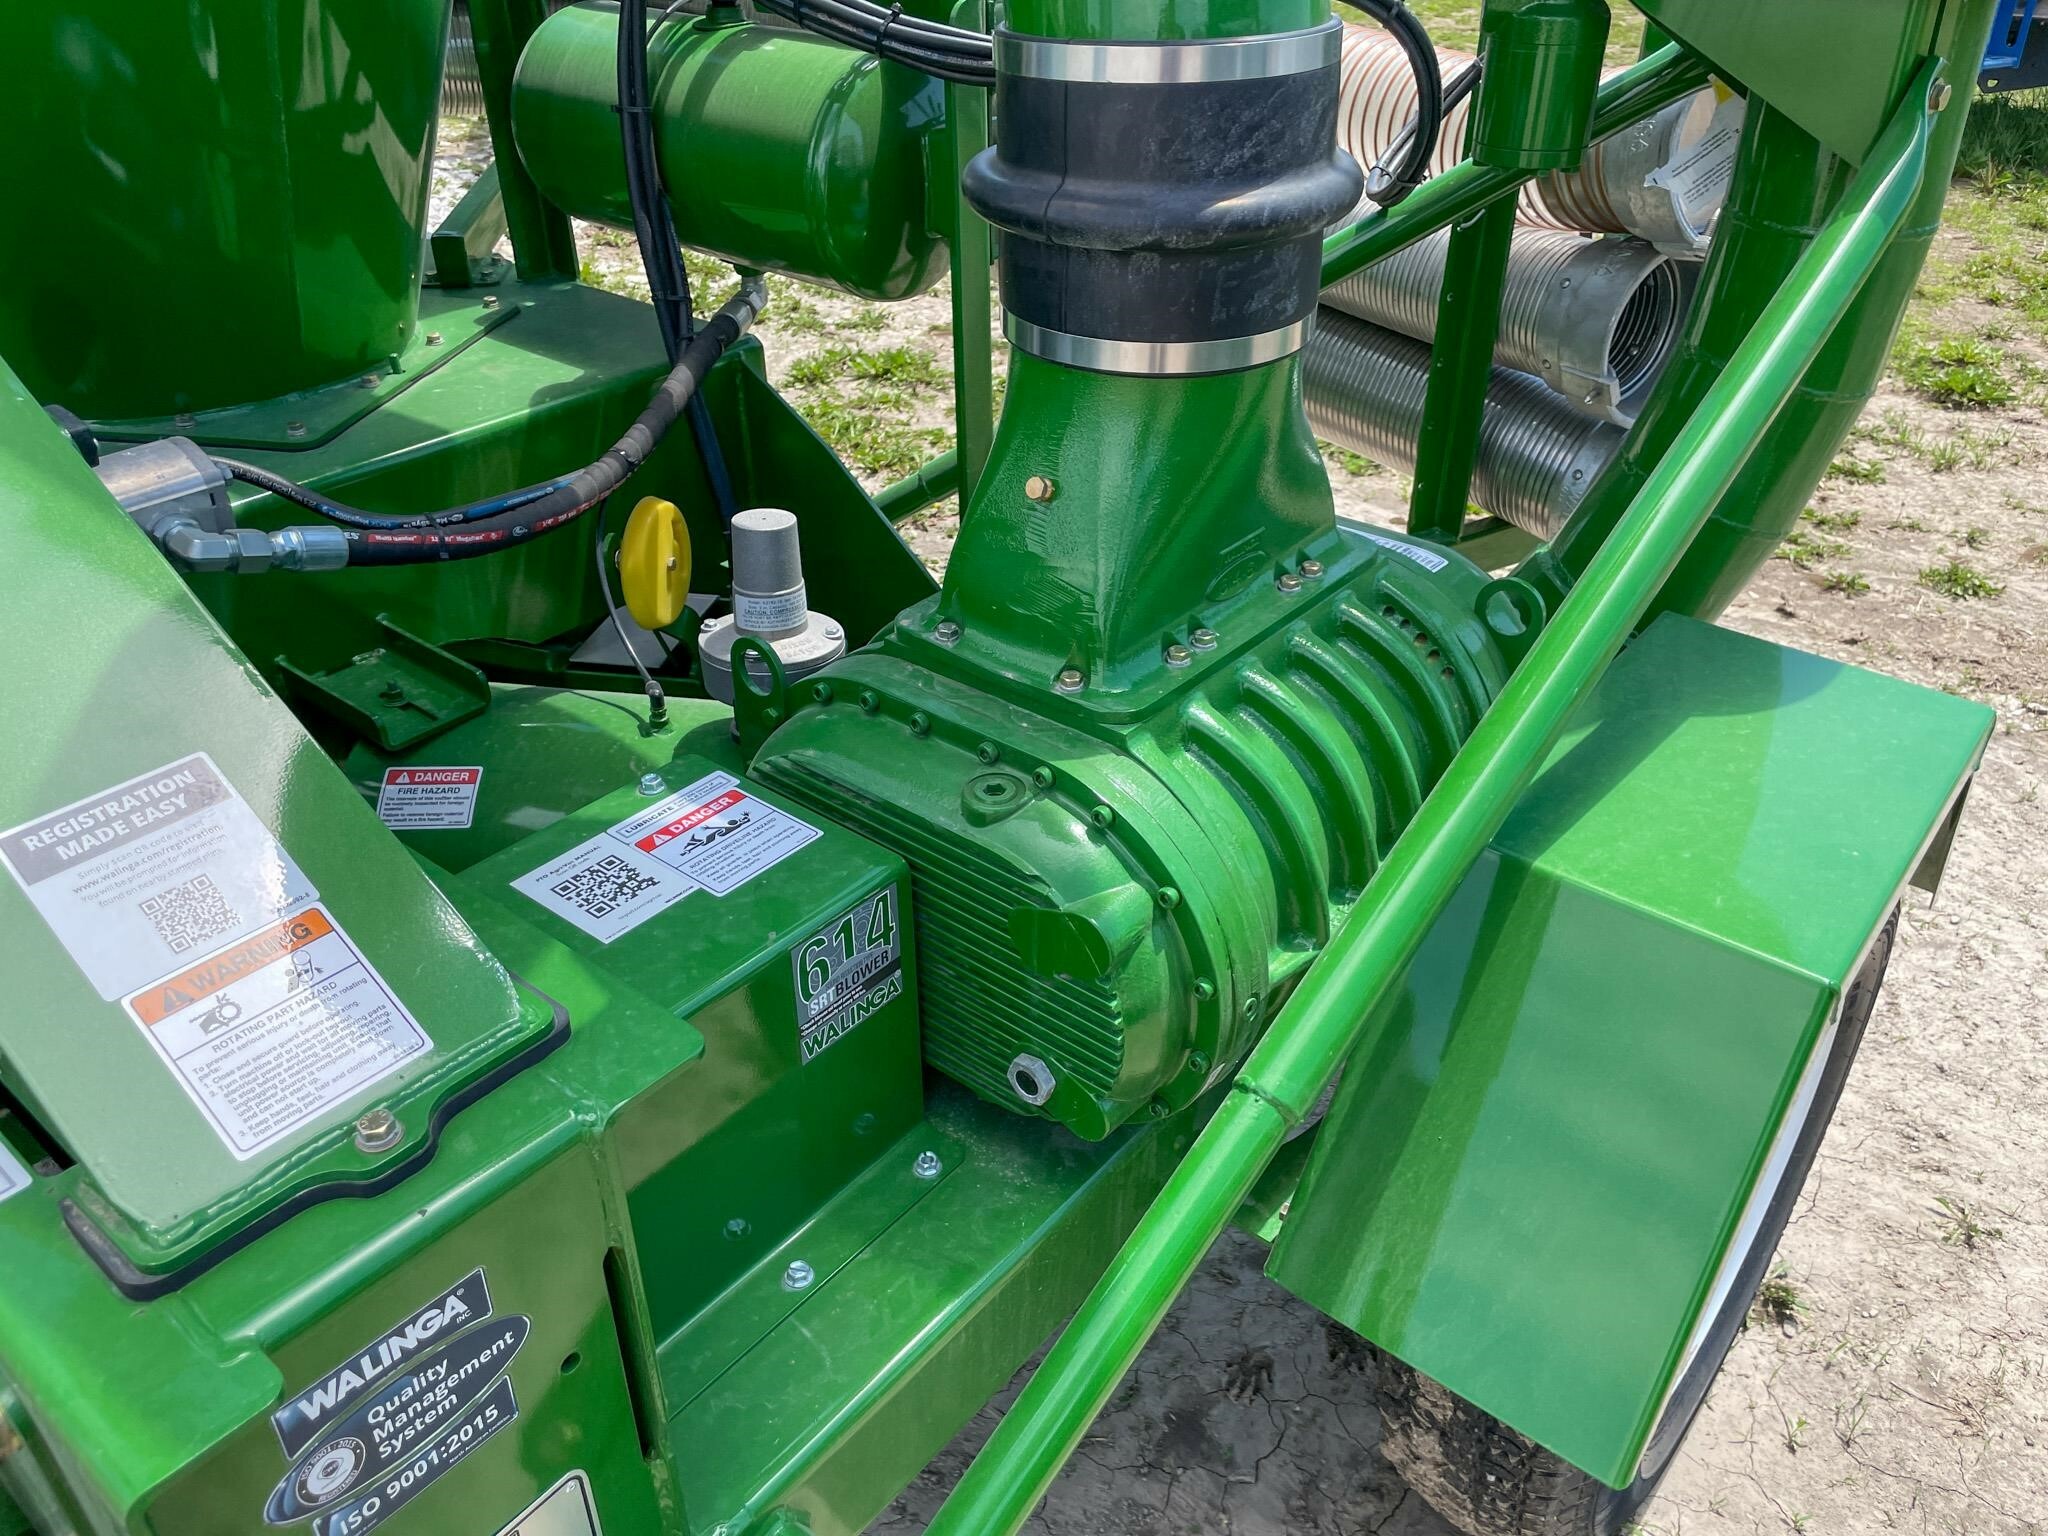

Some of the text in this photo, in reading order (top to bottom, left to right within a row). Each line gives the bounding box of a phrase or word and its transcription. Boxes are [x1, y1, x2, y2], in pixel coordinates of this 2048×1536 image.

[20, 769, 198, 852] REGISTRATION
[414, 772, 469, 781] DANGER
[54, 792, 192, 860] MADE EASY
[623, 805, 675, 833] LUBRICATE
[667, 796, 733, 833] DANGER
[688, 816, 778, 869] ROTATING DRIVELINE HAZARD
[76, 860, 111, 880] Simply
[109, 851, 133, 864] scan
[133, 843, 150, 855] QR
[149, 833, 172, 847] code
[113, 877, 126, 888] be
[125, 859, 169, 883] prompted
[573, 844, 601, 861] MANUAL
[97, 891, 125, 908] found
[186, 920, 313, 992] WARNING
[798, 890, 896, 1005] 614
[191, 976, 368, 1075] To prevent serious injury or death from rotating
[210, 980, 338, 1053] ROTATING PART HAZARD
[222, 1002, 387, 1098] electrical power and wait for all moving parts
[197, 1065, 223, 1082] parts:
[203, 1081, 212, 1089] 1.
[211, 1068, 236, 1084] Close
[234, 1059, 251, 1071] and
[250, 1045, 278, 1062] secure
[276, 1032, 301, 1049] guard
[299, 1019, 325, 1035] before
[208, 1013, 353, 1097] 2. Turn machine off or lock-out tag-out
[227, 1008, 393, 1105] to stop before servicing, adjusting, repairing,
[231, 1082, 279, 1112] unplugging
[277, 1077, 287, 1085] or
[286, 1050, 333, 1080] maintaining
[349, 1025, 377, 1044] Ensure
[375, 1017, 391, 1028] that
[236, 1023, 394, 1117] unit power source is completely shut down
[238, 1129, 248, 1137] 3.
[247, 1115, 270, 1132] Keep
[268, 1099, 298, 1119] hands,
[313, 1079, 331, 1092] hair
[329, 1071, 346, 1083] and
[345, 1053, 378, 1075] clothing
[376, 1042, 398, 1058] away
[240, 1075, 321, 1123] and can not start up.
[251, 1092, 326, 1138] from moving parts.
[367, 1358, 449, 1424] Quality
[372, 1329, 516, 1443] Management
[338, 1440, 357, 1449] 2015
[378, 1393, 458, 1459] System
[340, 1404, 499, 1536] ISO 9001:2015
